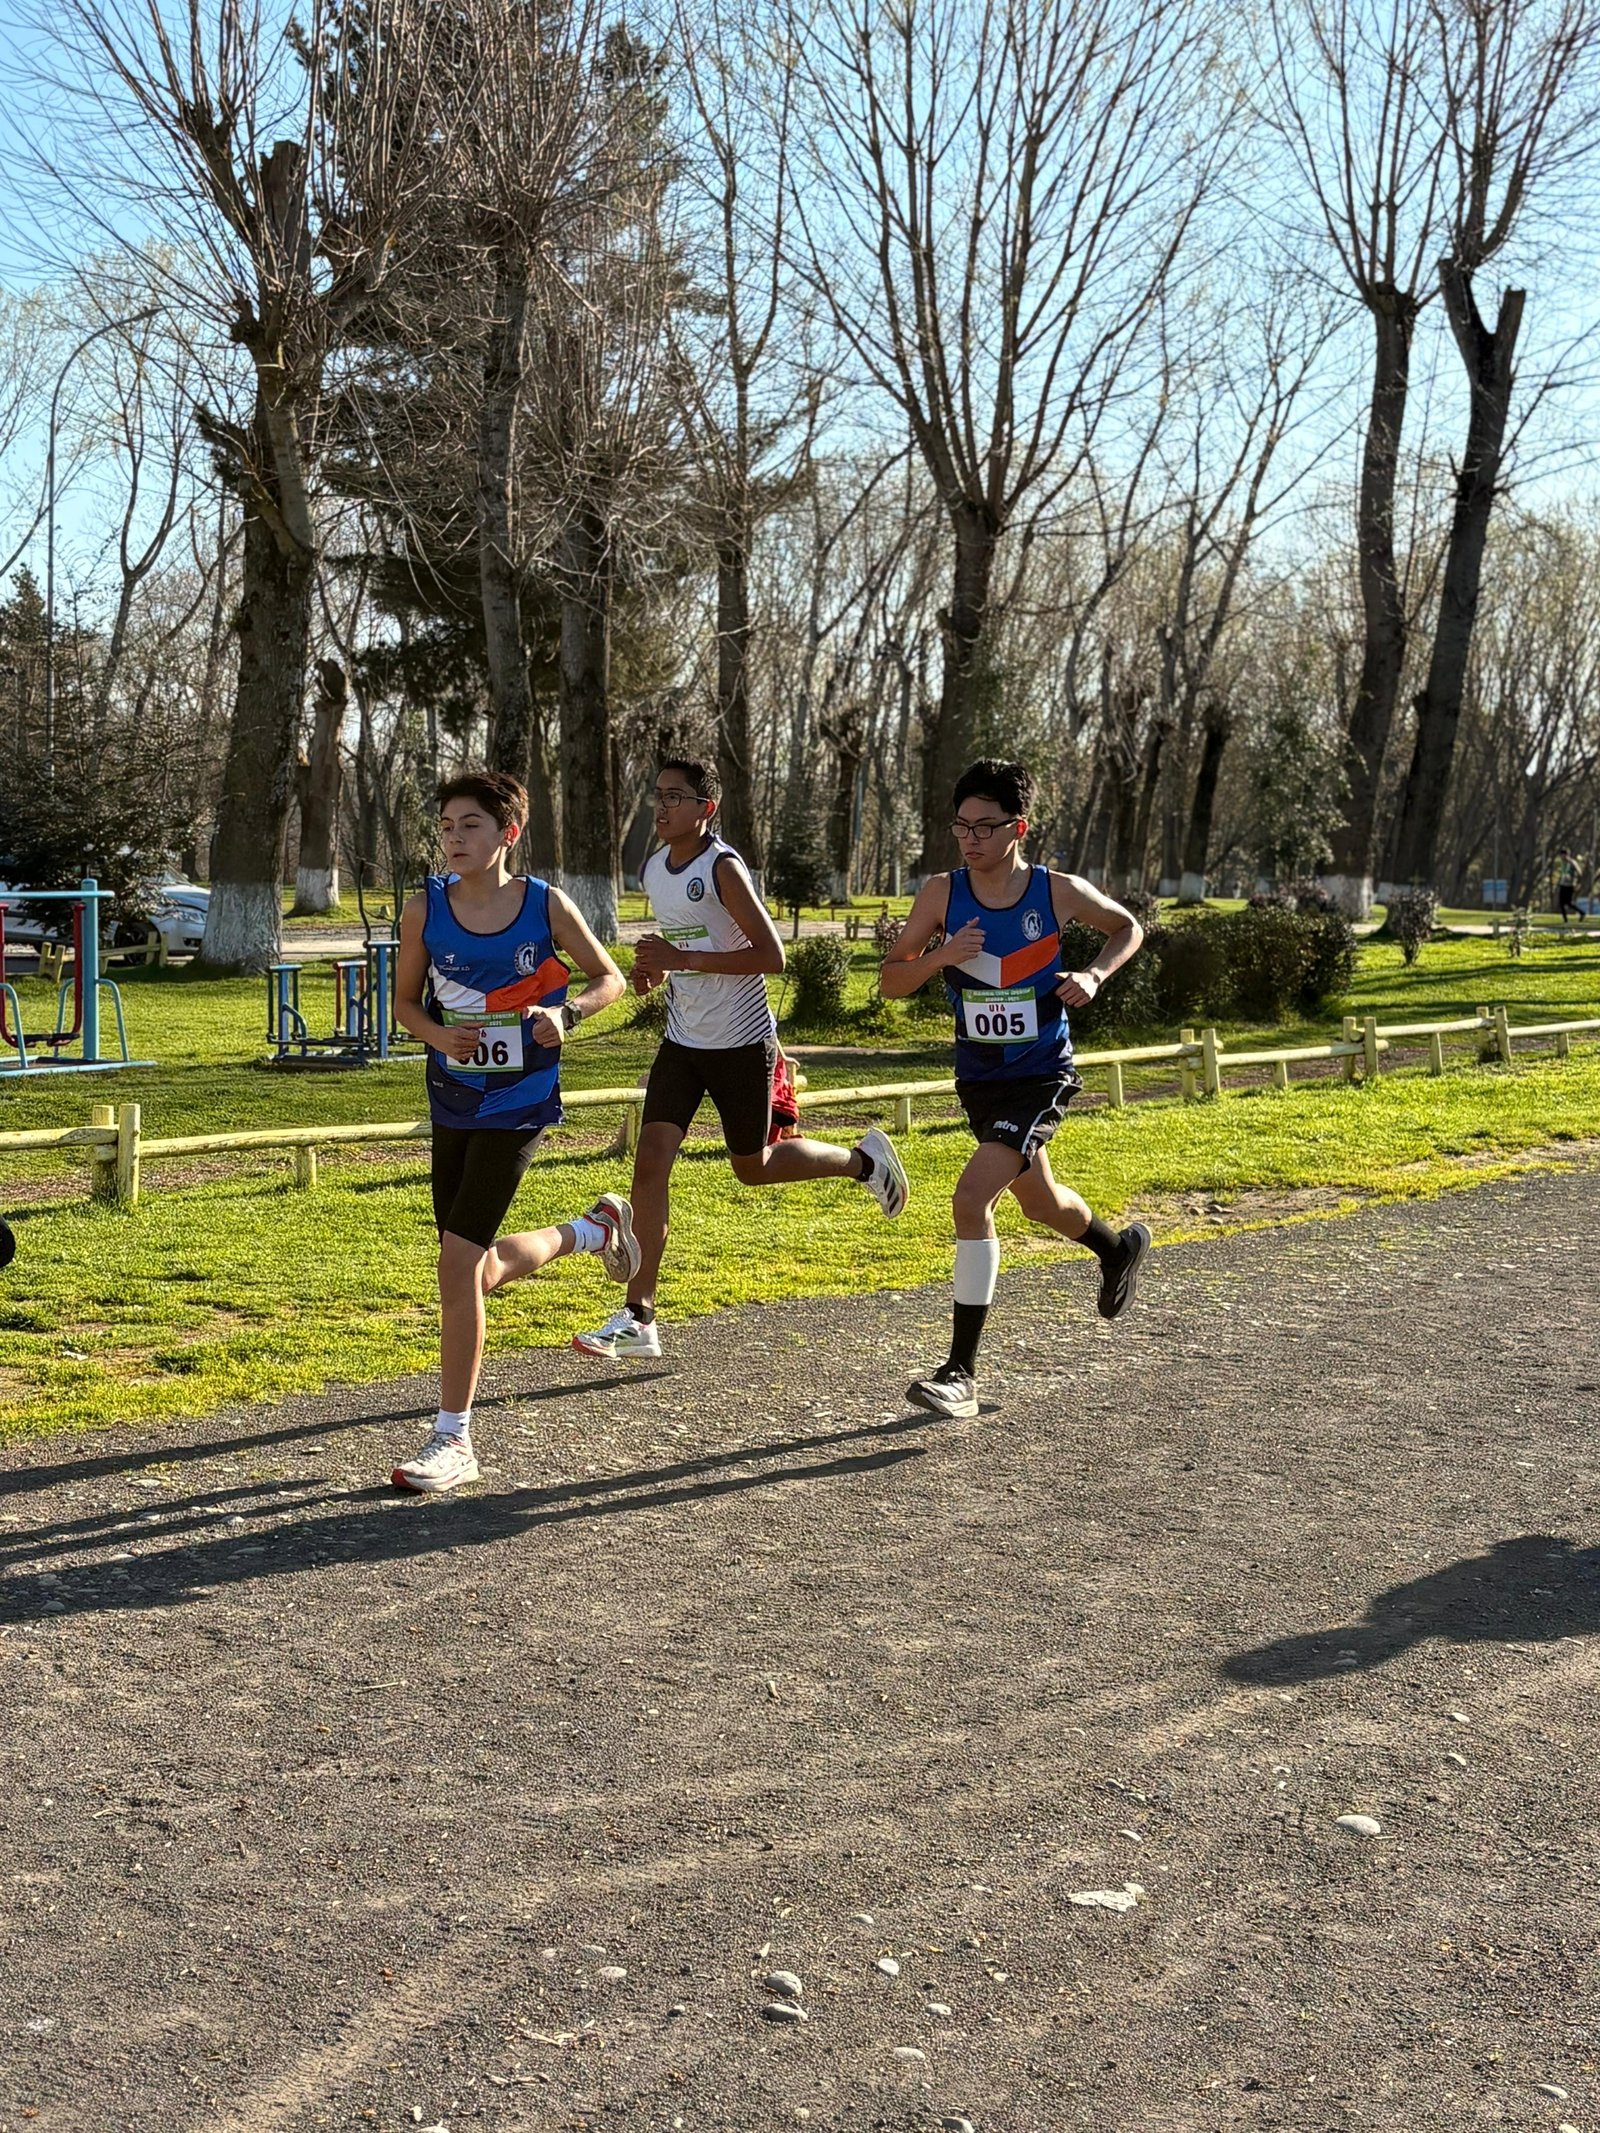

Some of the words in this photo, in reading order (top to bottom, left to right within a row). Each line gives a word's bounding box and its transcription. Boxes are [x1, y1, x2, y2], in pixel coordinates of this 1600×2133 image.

[988, 1004, 1006, 1012] U16
[975, 1013, 1025, 1036] 005
[459, 1040, 509, 1066] 06
